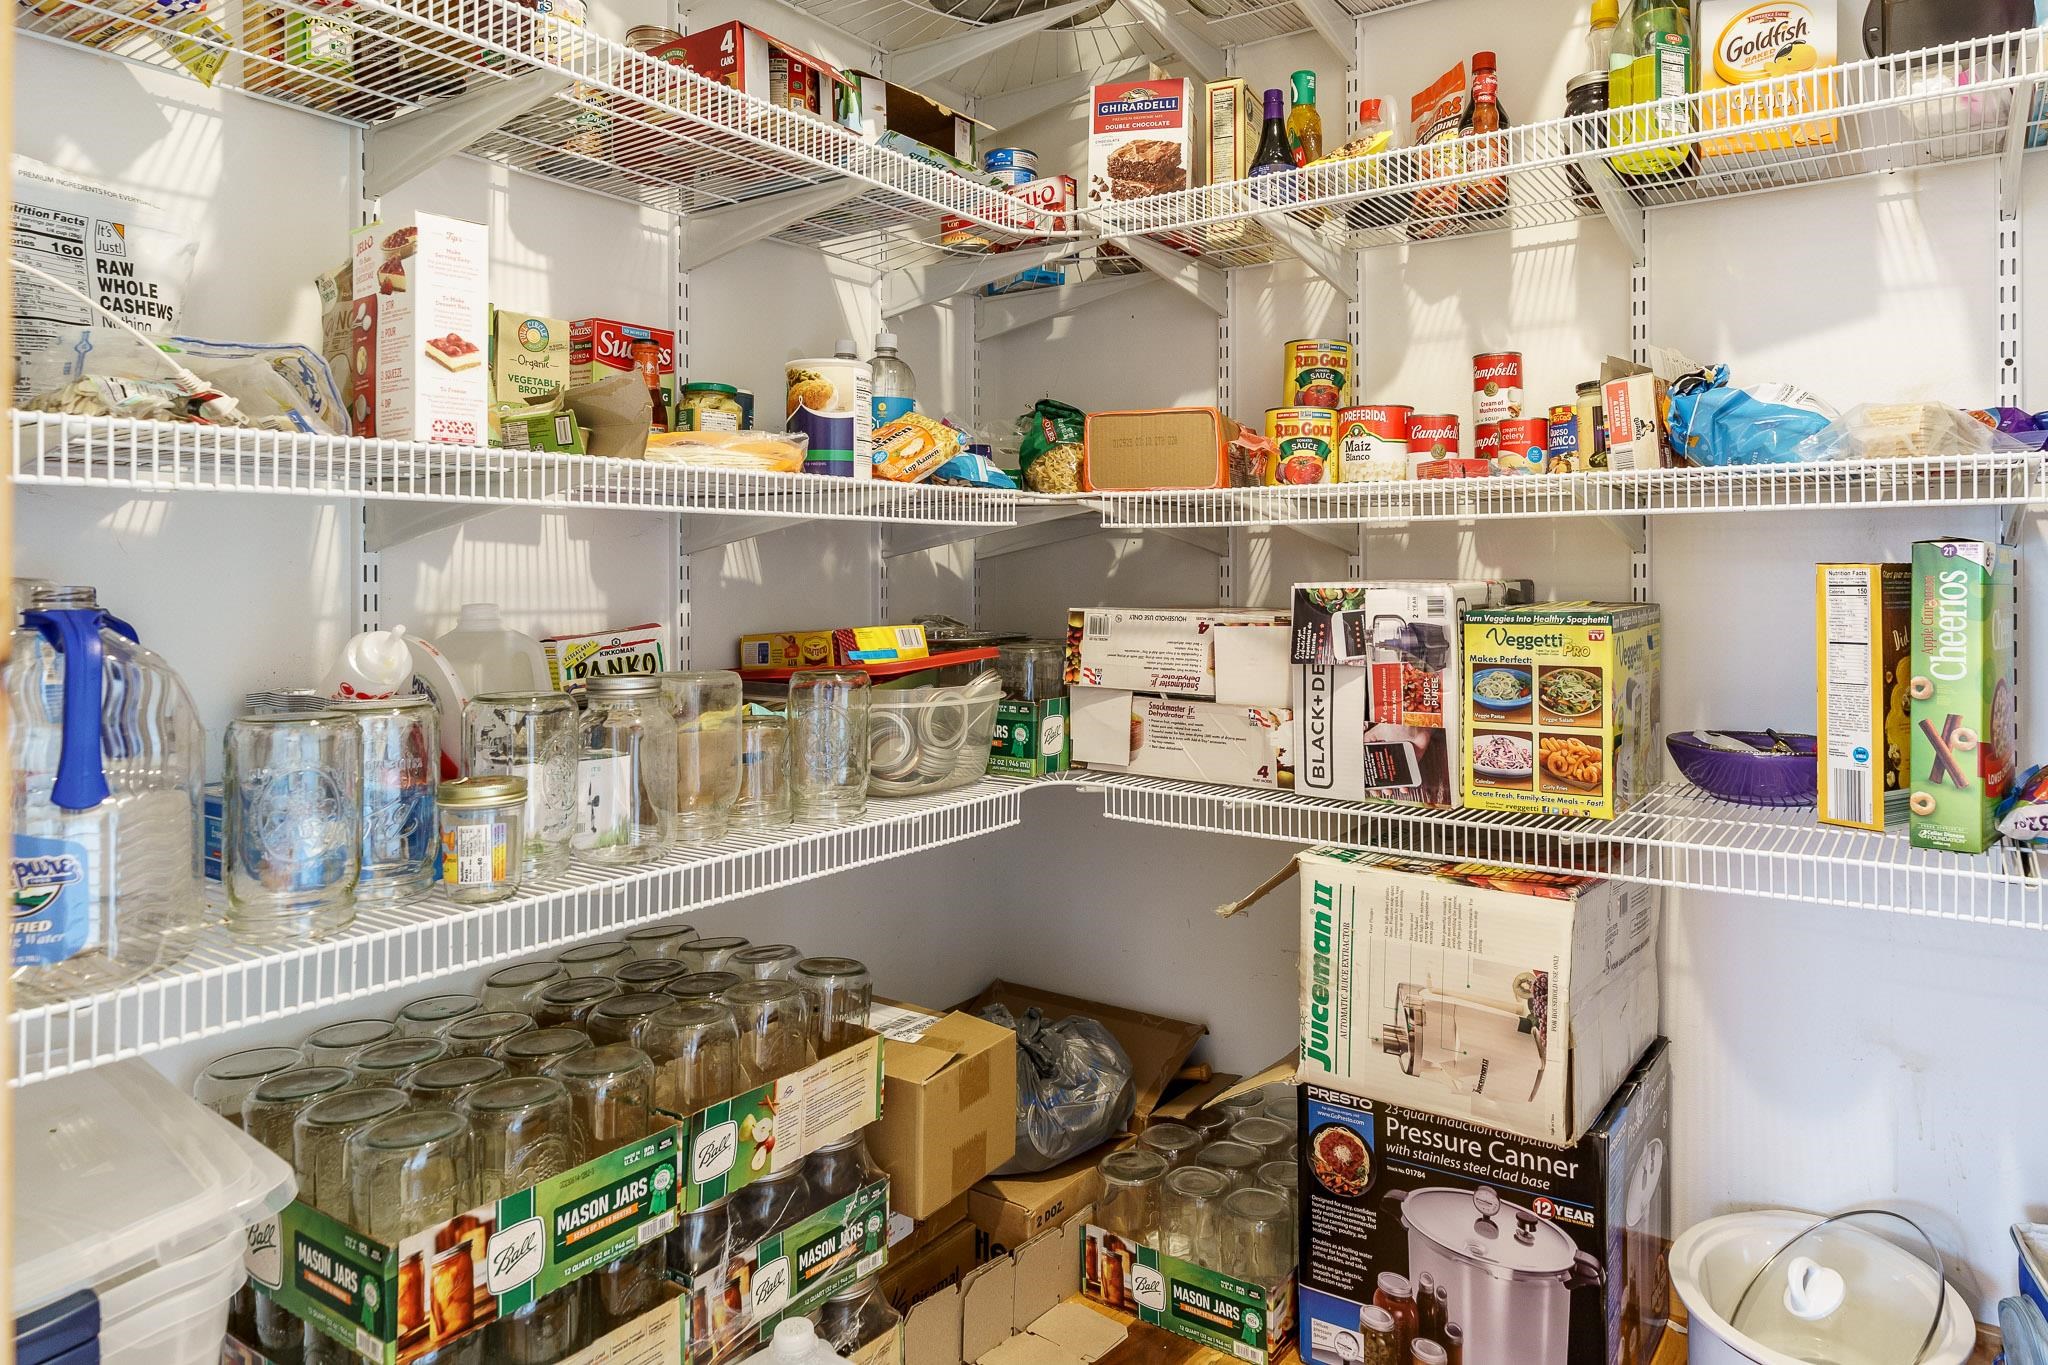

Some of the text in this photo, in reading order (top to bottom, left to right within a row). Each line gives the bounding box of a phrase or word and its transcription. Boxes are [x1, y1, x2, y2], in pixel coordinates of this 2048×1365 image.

[720, 29, 735, 54] 4
[1726, 17, 1808, 62] Goldfish
[720, 55, 735, 68] CANS
[1101, 100, 1176, 114] GHIRARDELLI
[1132, 120, 1170, 128] CHOCOLATE
[18, 169, 118, 199] PREMIUM INGREDIENTS FOR
[53, 212, 86, 227] Facts
[97, 223, 112, 238] It's
[51, 242, 84, 257] 160
[97, 239, 122, 255] Just!
[96, 258, 134, 278] RAW
[97, 276, 158, 300] WHOLE
[99, 295, 174, 323] CASHEWS
[518, 354, 550, 371] Organic
[1294, 354, 1348, 368] RED GOLD
[508, 374, 560, 388] VEGETABLE
[1310, 372, 1334, 381] SAUCE
[1344, 410, 1387, 423] PREFERIDA
[1480, 406, 1506, 414] Mushroom
[1618, 390, 1628, 436] STRAWBERRIES
[1275, 422, 1333, 438] RED GOLD
[1502, 432, 1525, 441] celery
[1550, 428, 1568, 437] Queso
[1633, 417, 1641, 441] QUAKER
[1291, 442, 1318, 452] SAUCE
[903, 448, 940, 474] Top Ramen
[1345, 452, 1370, 462] Blanco
[1144, 614, 1154, 622] USE
[1155, 614, 1187, 622] HOUSEHOLD
[1466, 614, 1482, 622] Turn
[1484, 614, 1515, 624] Veggies
[1533, 615, 1564, 625] Healthy
[1566, 616, 1610, 625] Spaghetti!
[1930, 569, 1968, 682] Cheerios
[1198, 622, 1210, 635] 4
[1486, 627, 1563, 650] Veggetti
[1892, 625, 1910, 652] Did
[1922, 624, 1937, 655] Apple
[564, 642, 592, 662] RESEALABLE
[600, 646, 635, 657] KIKKOMAN
[1469, 654, 1532, 664] Makes Perfect:
[1562, 643, 1591, 658] PRO
[574, 652, 656, 679] PANKO
[1158, 680, 1200, 691] Snackmaster
[1160, 674, 1200, 682] Dehydrator
[1430, 677, 1439, 706] PUREE
[1148, 702, 1186, 713] Snackmaster
[1148, 710, 1184, 719] Dehydrator
[1044, 724, 1062, 746] Ball
[1008, 760, 1019, 768] 946
[1257, 765, 1270, 778] 4
[1472, 790, 1494, 798] Create
[1495, 791, 1515, 800] Fresh,
[1516, 794, 1556, 803] Family-Size
[1927, 835, 1968, 844] FOUNDATION
[1308, 880, 1332, 1073] Juiceman II
[1339, 922, 1350, 1040] AUTOMATIC JUICE EXTRACTOR
[1308, 1086, 1373, 1110] PRESTO
[1317, 1110, 1365, 1126] www.GoPresto.com
[1384, 1104, 1435, 1124] 23-quart
[699, 1134, 733, 1169] Ball
[1386, 1116, 1579, 1180] Pressure Canner
[1386, 1143, 1550, 1190] with stainless steel clad base
[1405, 1167, 1426, 1179] 01784
[557, 1194, 609, 1236] MASON
[612, 1176, 648, 1210] JARS
[1036, 1200, 1066, 1228] 2 DOZ.
[1312, 1194, 1376, 1218] Designed confident
[1312, 1200, 1376, 1224] home pressure The
[1534, 1200, 1595, 1224] 12 YEAR
[1312, 1208, 1376, 1230] only method recommended
[1312, 1221, 1338, 1232] vegetables,
[1329, 1218, 1348, 1229] canning
[493, 1230, 536, 1278] Ball
[799, 1236, 836, 1272] MASON
[1312, 1237, 1373, 1260] Doubles boiling water
[298, 1242, 358, 1293] MASON JARS
[564, 1268, 572, 1276] 12
[572, 1258, 592, 1273] QUART
[593, 1254, 603, 1263] (32
[614, 1242, 626, 1252] 946
[1312, 1261, 1326, 1270] Works
[756, 1268, 786, 1306] Ball
[1134, 1276, 1162, 1295] Ball
[1173, 1284, 1210, 1310] MASON
[1212, 1300, 1240, 1321] JARS
[1185, 1326, 1200, 1336] QUART
